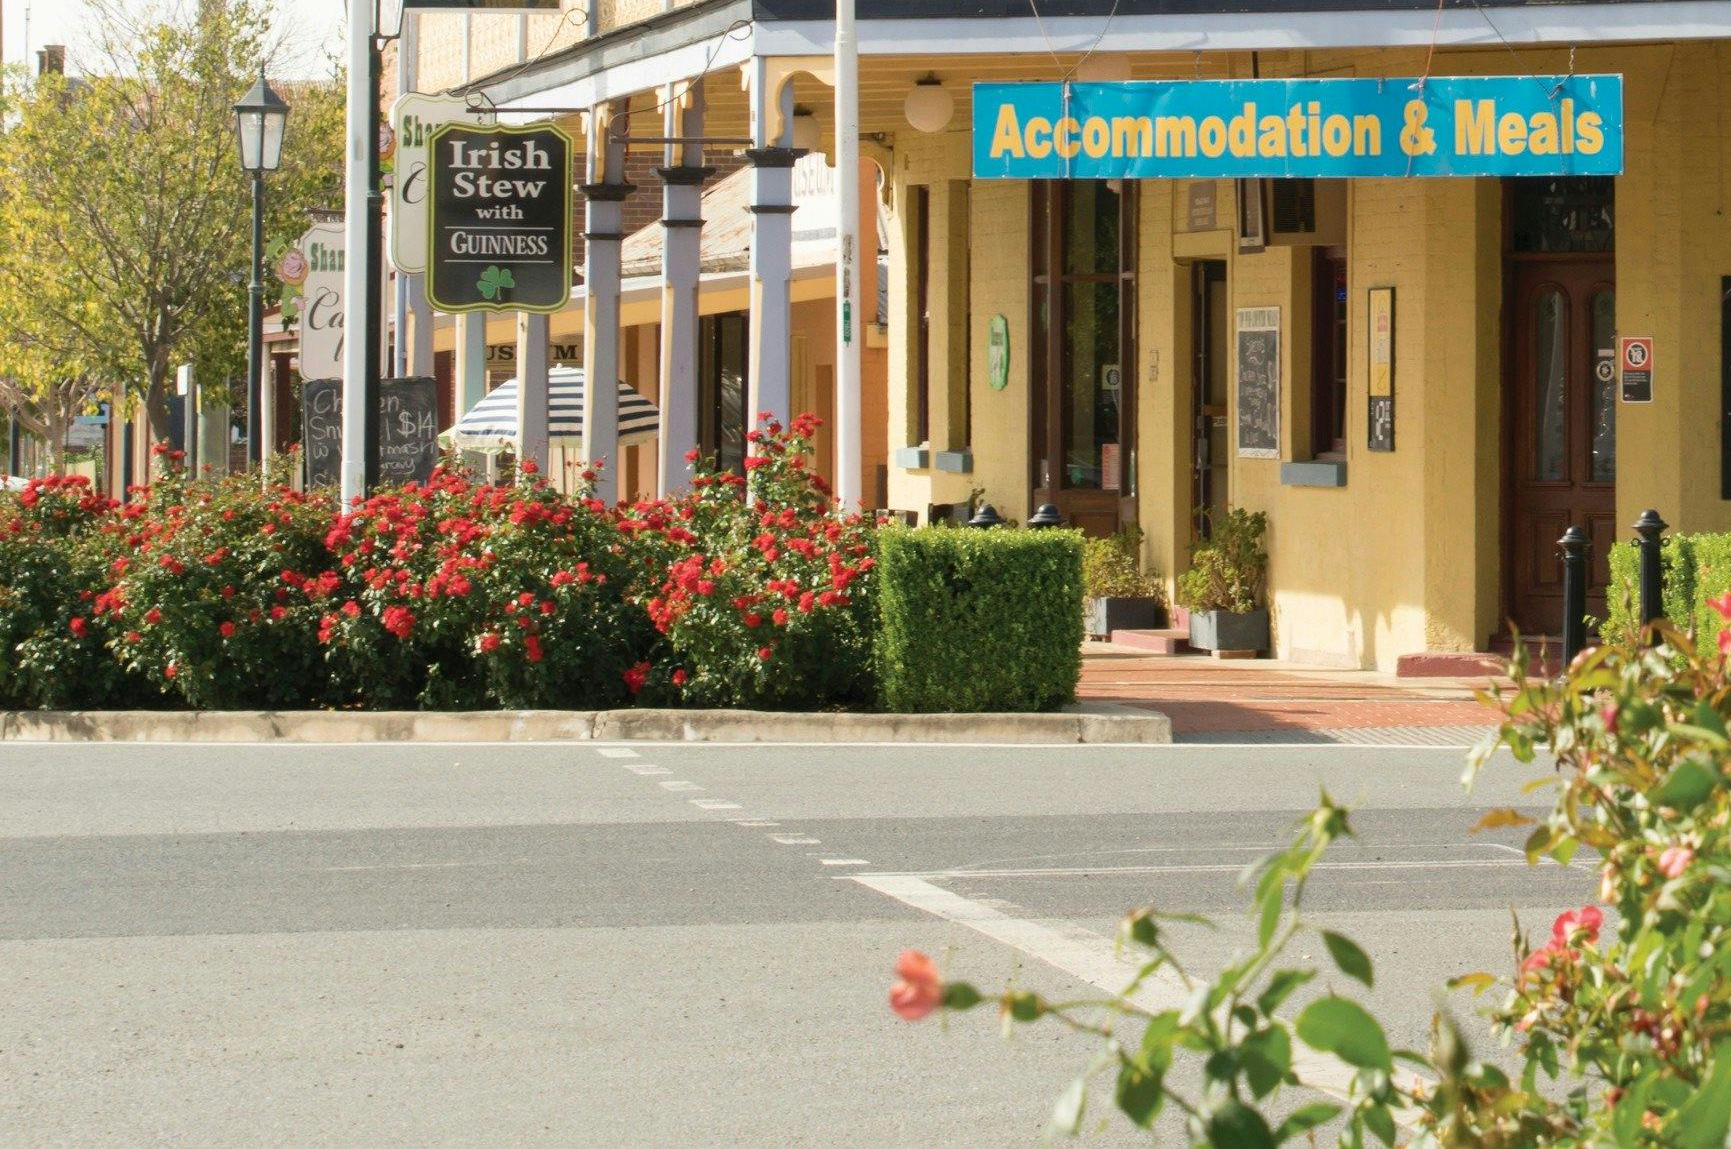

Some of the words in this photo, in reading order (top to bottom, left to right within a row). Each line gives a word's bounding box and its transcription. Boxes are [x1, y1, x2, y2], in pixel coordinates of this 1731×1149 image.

[989, 101, 1382, 159] Accommodation
[1400, 99, 1437, 156] &
[1454, 98, 1604, 156] Meals
[448, 140, 552, 170] Irish
[453, 172, 546, 199] Stew
[476, 204, 524, 220] with
[450, 231, 548, 256] GUINNESS
[397, 410, 435, 440] $14
